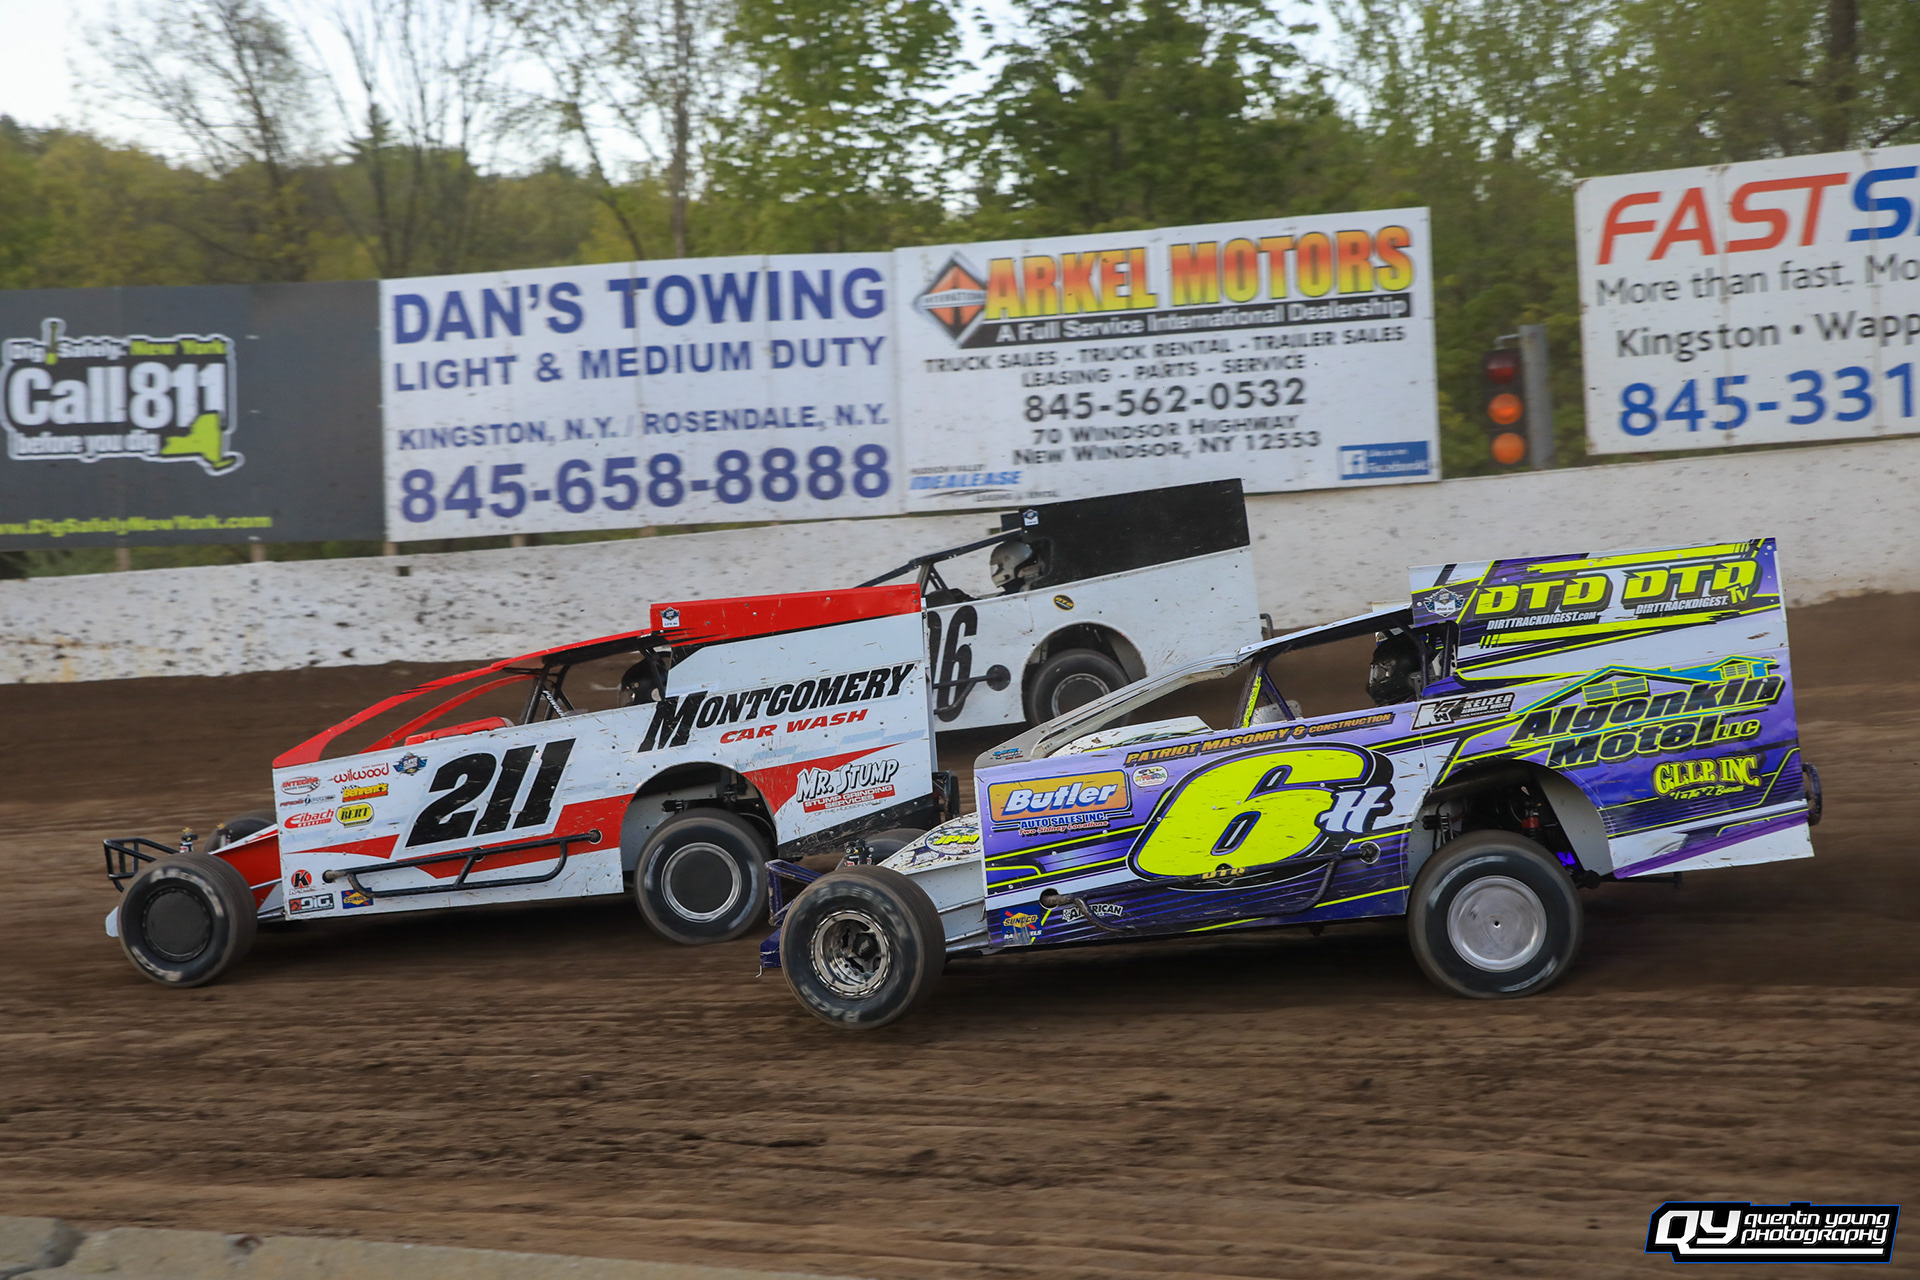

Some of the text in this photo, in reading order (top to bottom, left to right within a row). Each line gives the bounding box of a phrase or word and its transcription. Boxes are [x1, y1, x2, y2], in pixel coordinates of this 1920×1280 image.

[1595, 166, 1920, 265] FASTS
[984, 225, 1413, 320] ARKEL MOTORS
[1596, 276, 1680, 306] More
[1690, 267, 1768, 299] than
[1778, 260, 1854, 290] fast.
[393, 267, 886, 344] DAN'S TOWING
[996, 297, 1408, 342] A Full Service International Dealership
[394, 336, 886, 392] LIGHT & MEDIUM DUTY
[923, 355, 991, 373] TRUCK
[996, 351, 1058, 369] SALES
[1079, 344, 1147, 363] TRUCK
[1152, 339, 1233, 358] RENTAL
[1253, 331, 1335, 351] TRAILER
[1341, 327, 1406, 344] SALES
[1616, 323, 1780, 362] Kingston
[1021, 368, 1112, 388] LEASING
[1134, 363, 1199, 380] PARTS
[1221, 355, 1306, 374] SERVICE
[8, 362, 226, 428] Call 811
[1024, 377, 1306, 422] 845-562-0532
[1620, 362, 1914, 436] 845-331
[397, 420, 556, 450] KINGSTON,
[564, 417, 618, 440] N.Y.
[642, 405, 826, 435] ROSENDALE,
[834, 403, 889, 426] N.Y.
[1012, 431, 1322, 466] NEW WINDSOR, NY 12553
[1032, 415, 1299, 444] 70 WINDSOR HIGHWAY
[401, 443, 891, 524] 845-658-8888
[1474, 560, 1757, 615] DTD DTD
[638, 664, 915, 753] MONTGOMERY
[720, 709, 869, 744] CAR WASH
[1125, 713, 1391, 765] PATRIOT MASONRY & CONSTRUCTION
[1546, 713, 1760, 769] Motel LLC
[282, 777, 319, 788] INTEGRA
[333, 762, 390, 783] wilwood
[404, 738, 577, 848] 211
[796, 759, 899, 803] MR. STUMP
[284, 808, 334, 829] Eibach
[340, 807, 368, 821] BERT
[804, 785, 893, 807] STUMP GRINDING
[825, 794, 875, 808] SERVICES
[1003, 782, 1118, 815] Butler
[932, 834, 979, 845] JPM
[1020, 812, 1108, 829] AUTO SALES INC.
